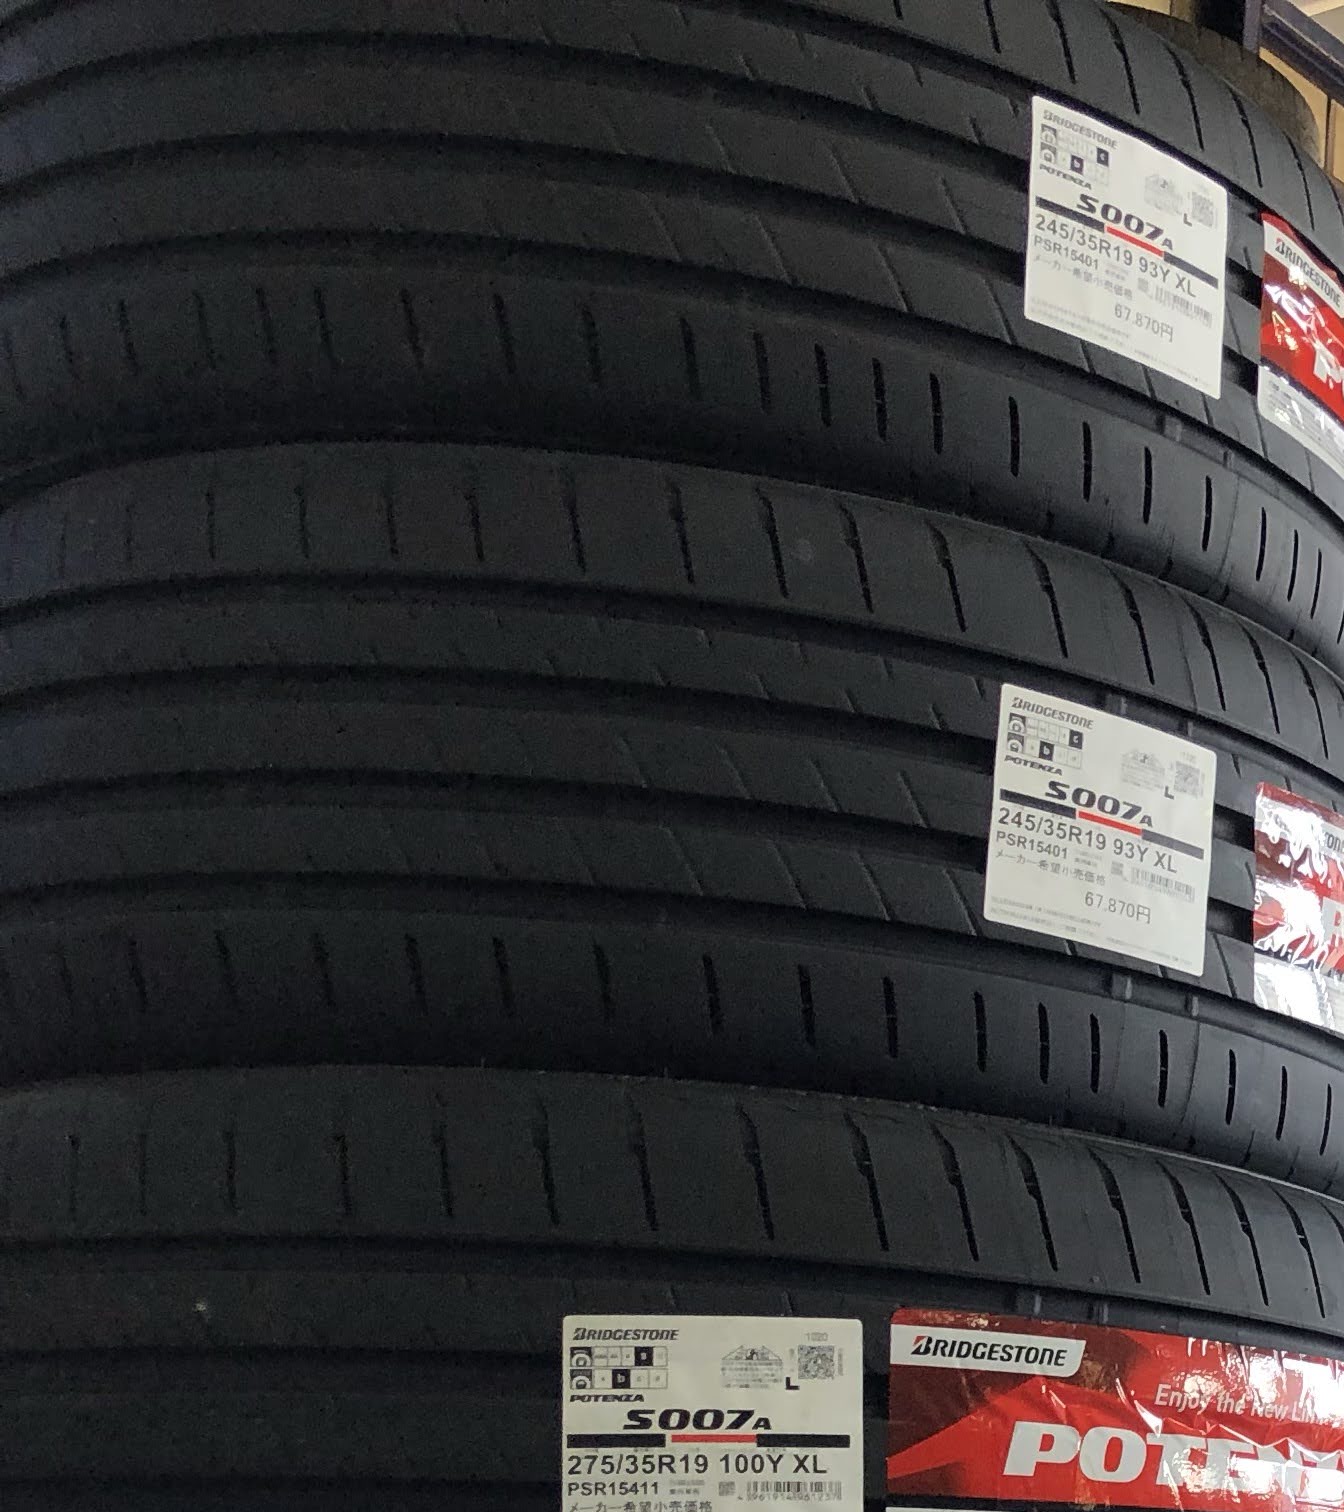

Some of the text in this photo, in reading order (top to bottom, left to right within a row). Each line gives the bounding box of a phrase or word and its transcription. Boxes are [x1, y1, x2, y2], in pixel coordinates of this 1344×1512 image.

[1042, 109, 1118, 151] BRIDGESTONE
[1183, 213, 1192, 227] L
[1034, 235, 1099, 271] PSR15401
[1035, 214, 1133, 266] 245/35R19
[1138, 256, 1171, 283] 93Y
[1175, 273, 1196, 298] XL
[1275, 237, 1341, 308] BRIDGESTONE
[1011, 697, 1094, 730] BRIDGESTONE
[1004, 754, 1063, 776] POTENZA
[1045, 780, 1153, 828] S007A
[1164, 785, 1175, 800] L
[996, 830, 1068, 859] PSR15401
[998, 807, 1107, 850] 245/35R19
[1113, 838, 1149, 863] 93Y
[1153, 850, 1178, 873] XL
[573, 1327, 680, 1341] BRIDGESTONE
[911, 1335, 1068, 1367] BRIDGESTONE
[785, 1376, 800, 1390] L
[570, 1394, 645, 1403] POTENZA
[1155, 1383, 1212, 1415] Enjoy
[623, 1408, 772, 1431] S007A
[567, 1453, 827, 1476] 275/35R19 100Y XL
[567, 1481, 659, 1497] PSR15411
